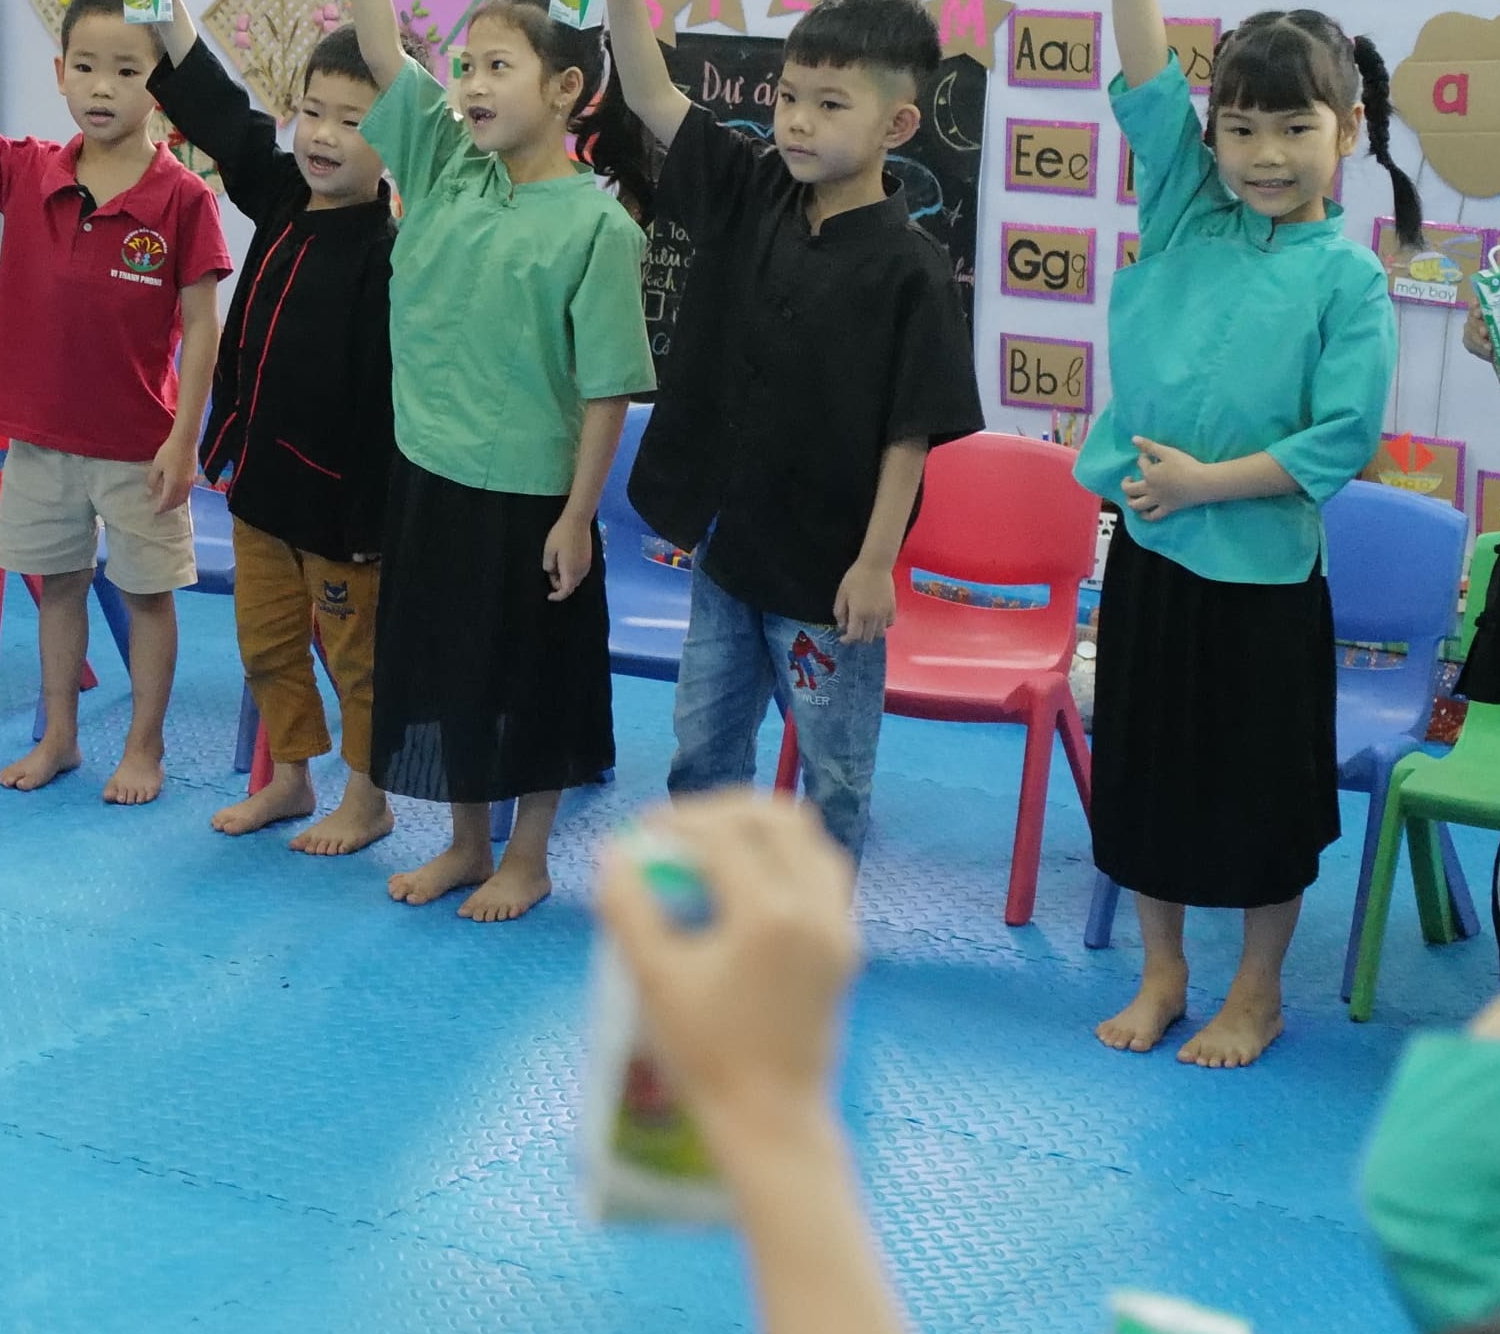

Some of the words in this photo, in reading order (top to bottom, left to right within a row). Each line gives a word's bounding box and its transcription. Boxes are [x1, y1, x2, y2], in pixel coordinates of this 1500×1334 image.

[702, 60, 744, 111] Dự
[754, 73, 778, 107] á
[1432, 73, 1469, 116] a
[1395, 281, 1426, 299] máy
[1428, 285, 1456, 301] bay
